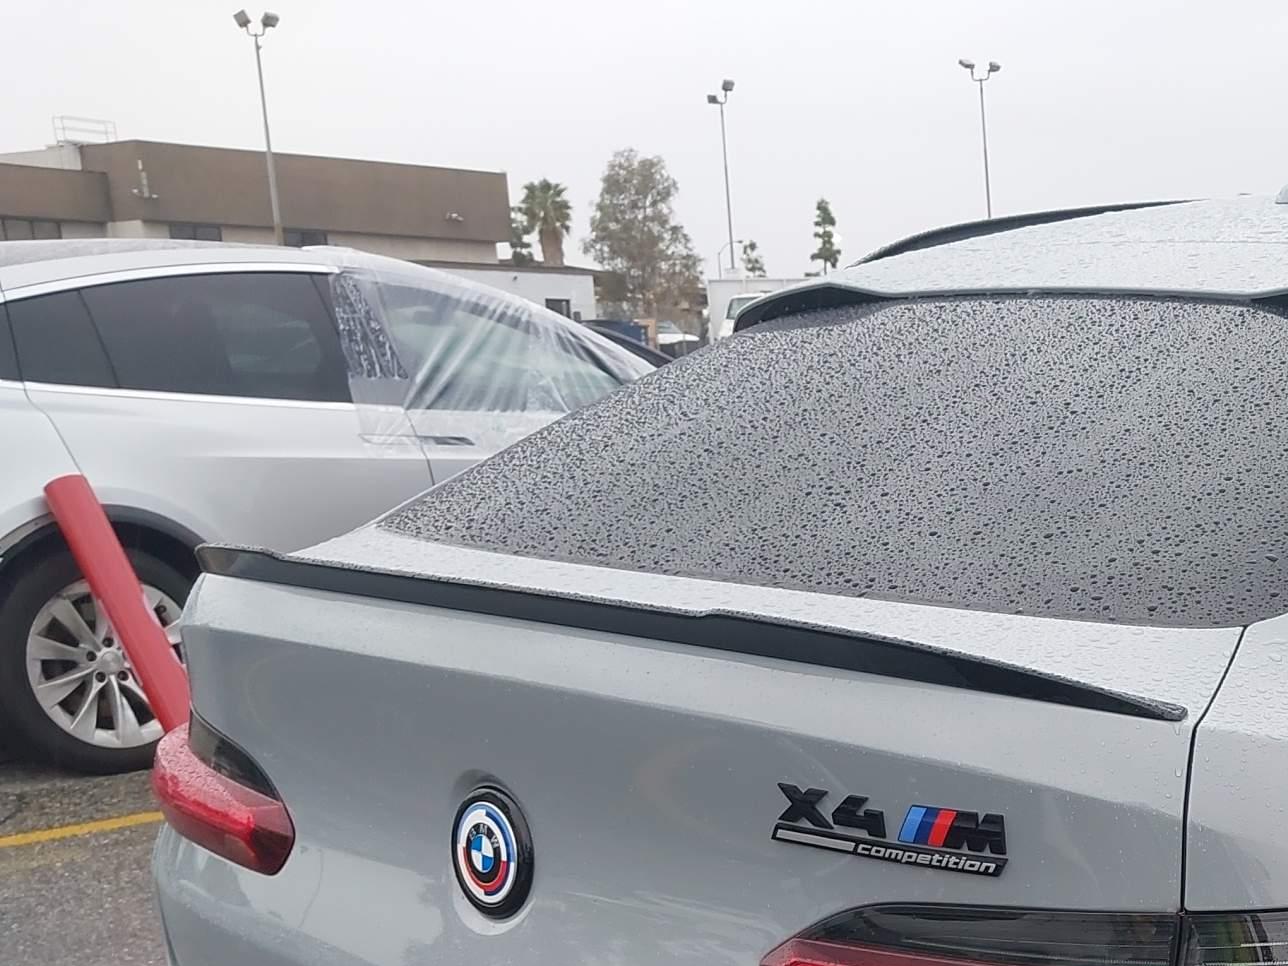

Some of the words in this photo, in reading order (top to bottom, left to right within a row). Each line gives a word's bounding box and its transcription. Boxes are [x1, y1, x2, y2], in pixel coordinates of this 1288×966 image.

[777, 782, 887, 839] X4
[469, 823, 500, 849] BMW
[856, 843, 996, 874] competition
